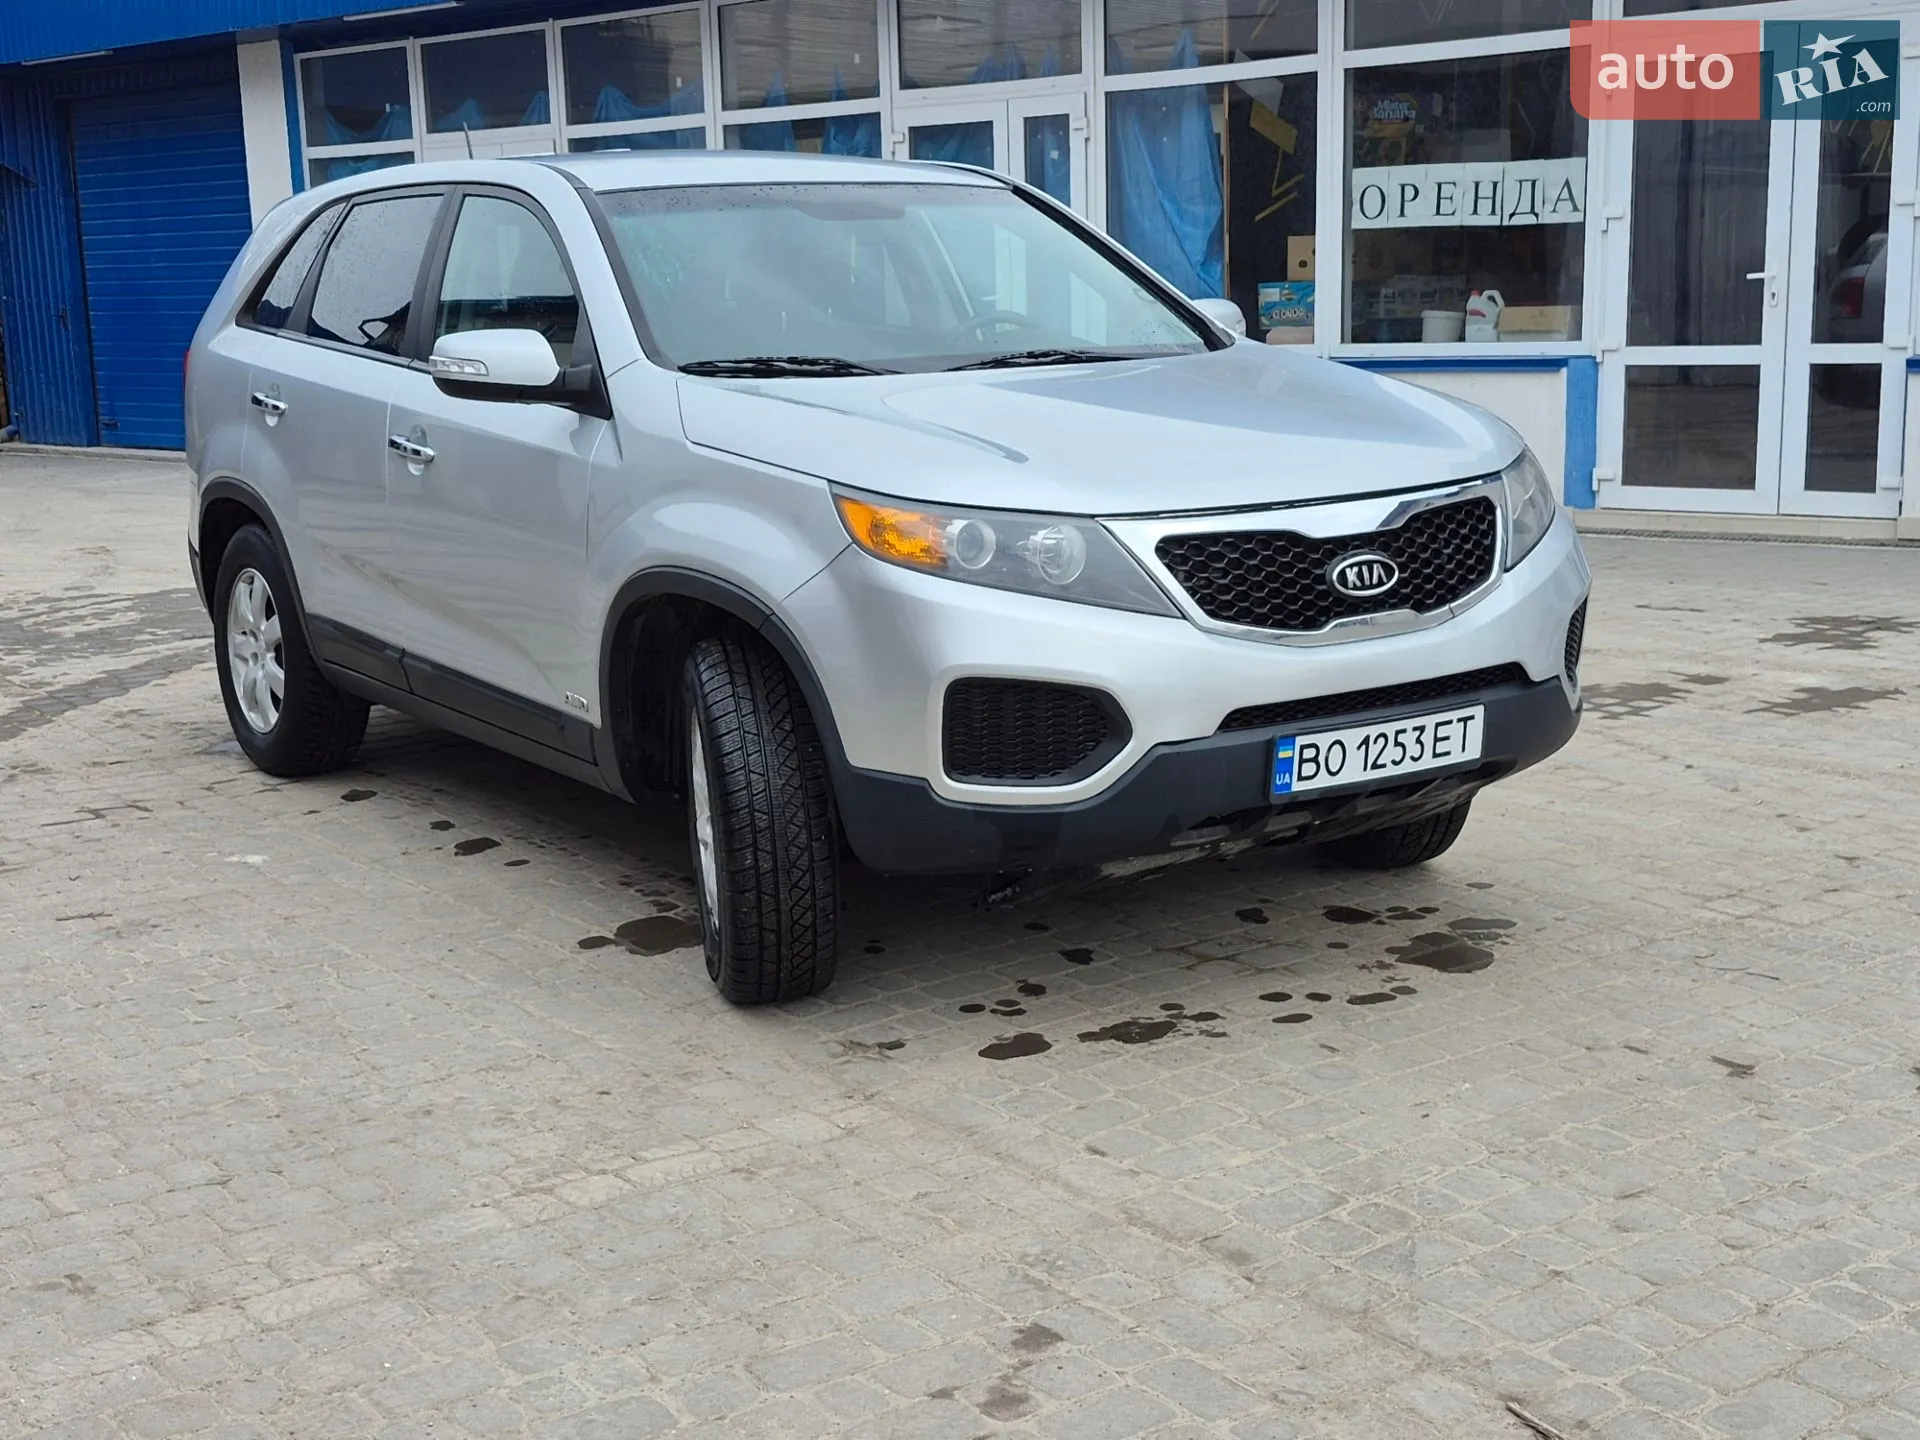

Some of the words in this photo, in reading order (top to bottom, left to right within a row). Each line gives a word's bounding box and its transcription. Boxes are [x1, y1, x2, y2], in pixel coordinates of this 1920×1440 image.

[1358, 176, 1582, 225] ОРЕНДА
[1344, 562, 1388, 589] KIA
[1296, 738, 1347, 783] BO
[1275, 773, 1291, 786] UA
